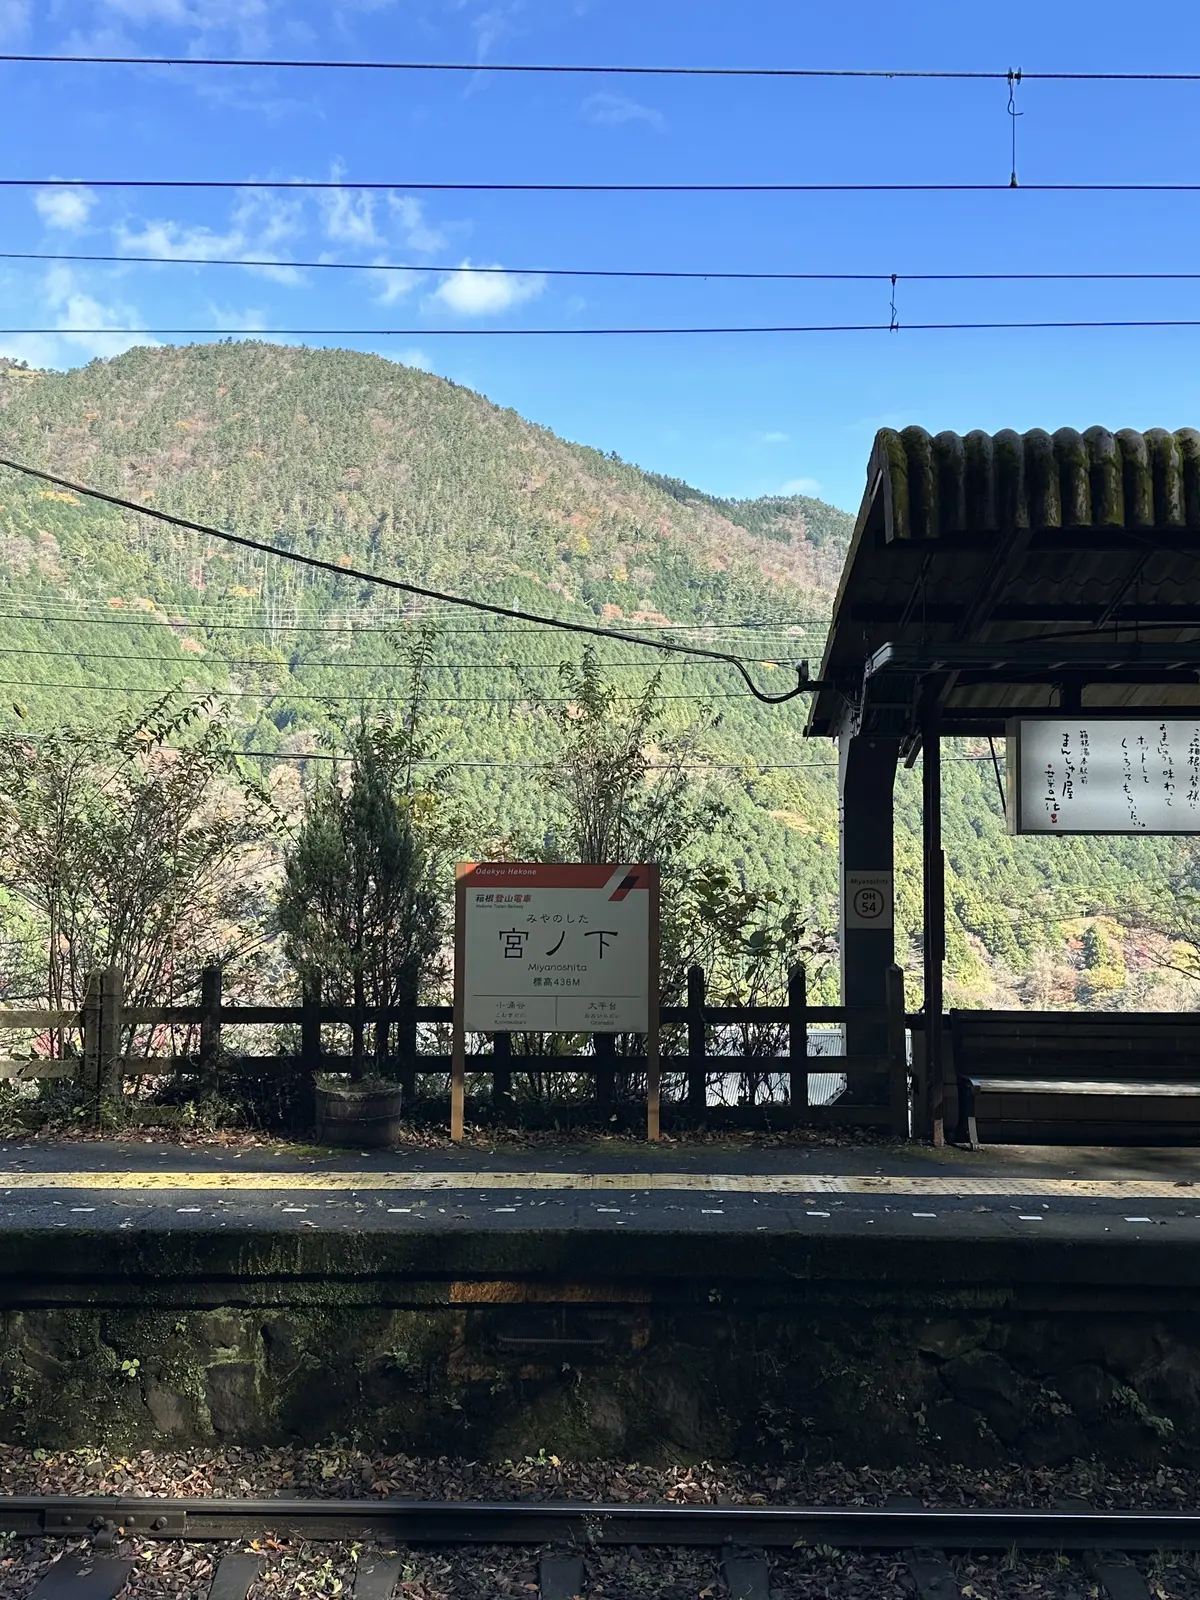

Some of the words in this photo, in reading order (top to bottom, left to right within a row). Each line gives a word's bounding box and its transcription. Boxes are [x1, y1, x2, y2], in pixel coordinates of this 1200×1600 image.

[1077, 729, 1091, 785] 箱根湯本駅前
[1136, 735, 1150, 784] ホットして
[1061, 732, 1076, 800] まんじゅう屋
[1157, 723, 1176, 807] おまんじゅうを味わって
[475, 867, 506, 876] Odakyu
[507, 867, 537, 875] Hakone
[475, 893, 533, 903] 箱根登山電車
[861, 892, 876, 900] OH
[861, 902, 877, 913] 54
[526, 914, 589, 924] みやのした
[499, 927, 619, 960] 宮ノ下
[527, 963, 588, 973] Miyanoshita
[533, 977, 581, 987] 標高436M
[588, 1002, 617, 1011] 大平台
